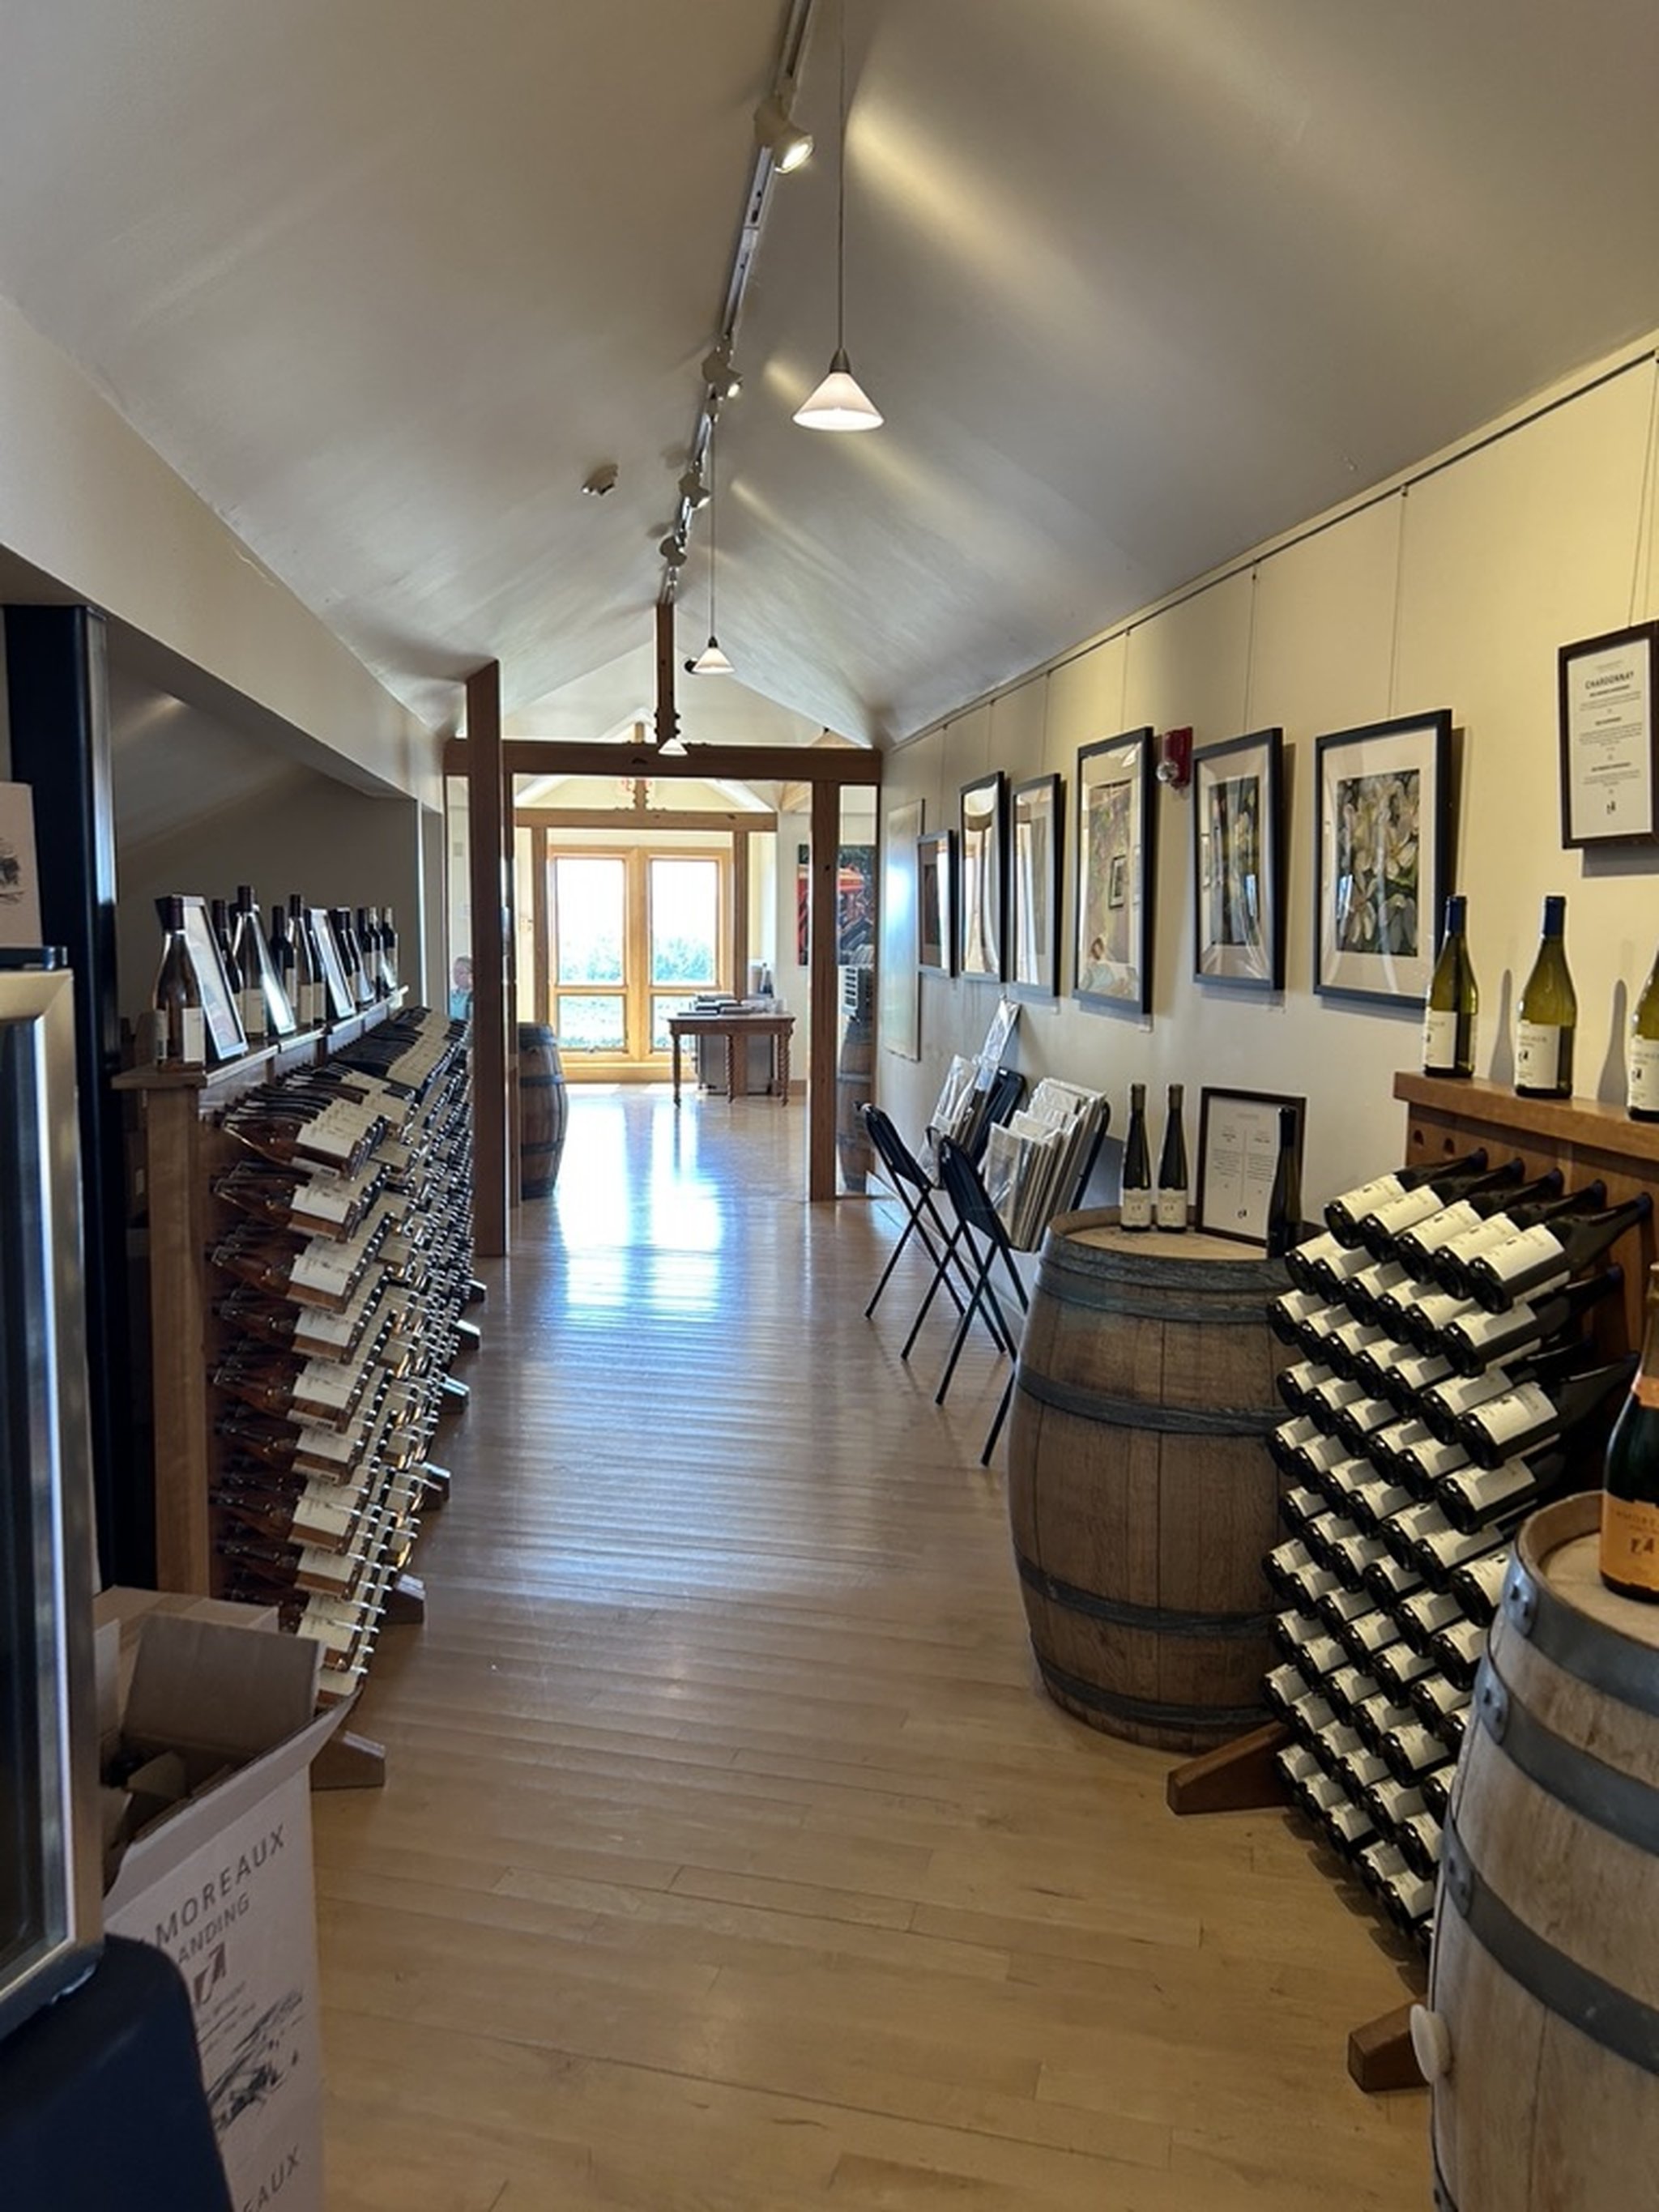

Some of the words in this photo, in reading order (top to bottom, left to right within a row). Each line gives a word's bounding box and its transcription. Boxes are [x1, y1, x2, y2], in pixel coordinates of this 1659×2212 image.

[140, 1823, 284, 1948] MOREAUX
[178, 1892, 250, 1964] ANDING
[243, 2142, 299, 2212] EAUX
